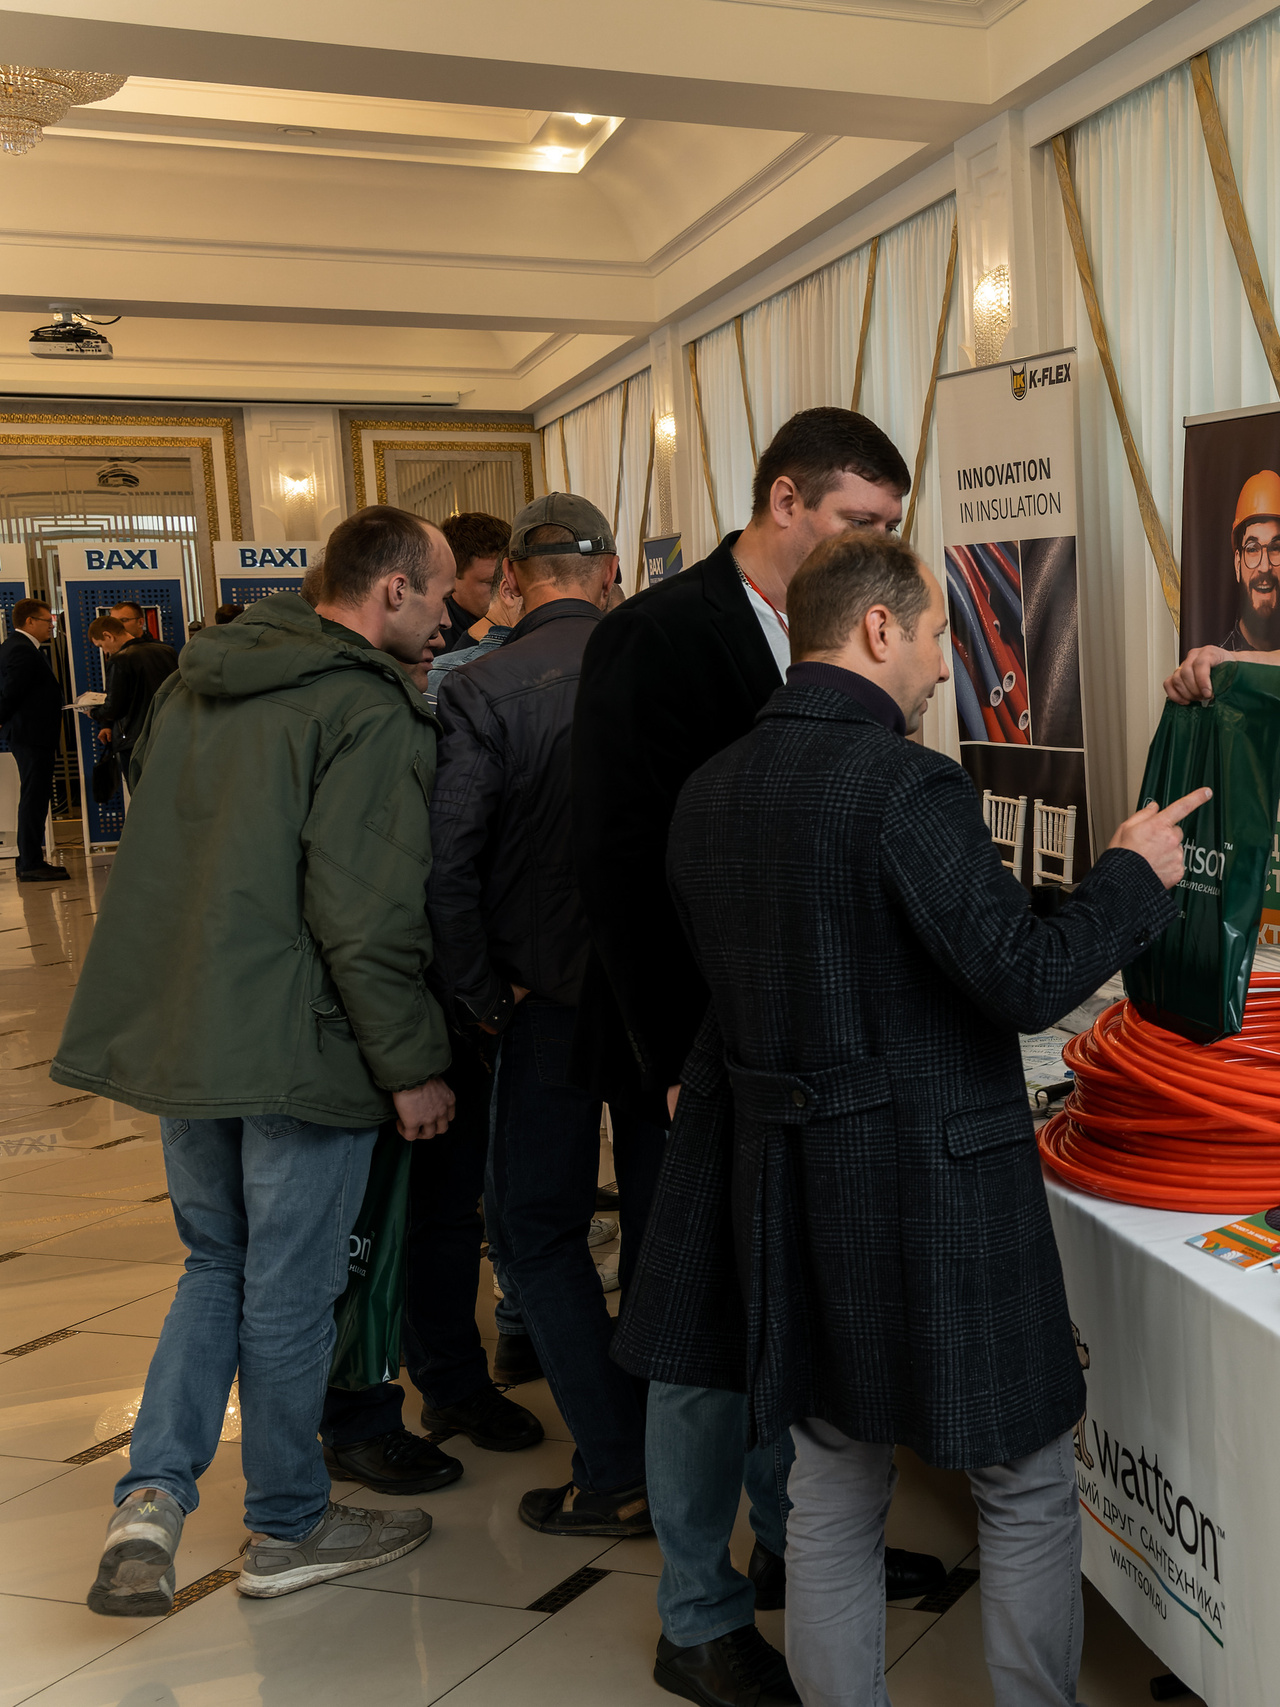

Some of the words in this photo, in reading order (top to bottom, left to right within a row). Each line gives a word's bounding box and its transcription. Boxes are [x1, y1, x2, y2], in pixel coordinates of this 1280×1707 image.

[1029, 363, 1071, 389] K-FLEX
[957, 457, 1051, 491] INNOVATION
[960, 501, 974, 523] IN
[976, 491, 1062, 521] INSULATION
[84, 549, 158, 571] BAXI
[239, 548, 308, 569] BAXI
[649, 557, 664, 576] BAXI
[1103, 1496, 1135, 1537] ДРУГ
[1140, 1526, 1223, 1629] САНТЕХНИКА
[1110, 1546, 1167, 1620] WATTSON.RU
